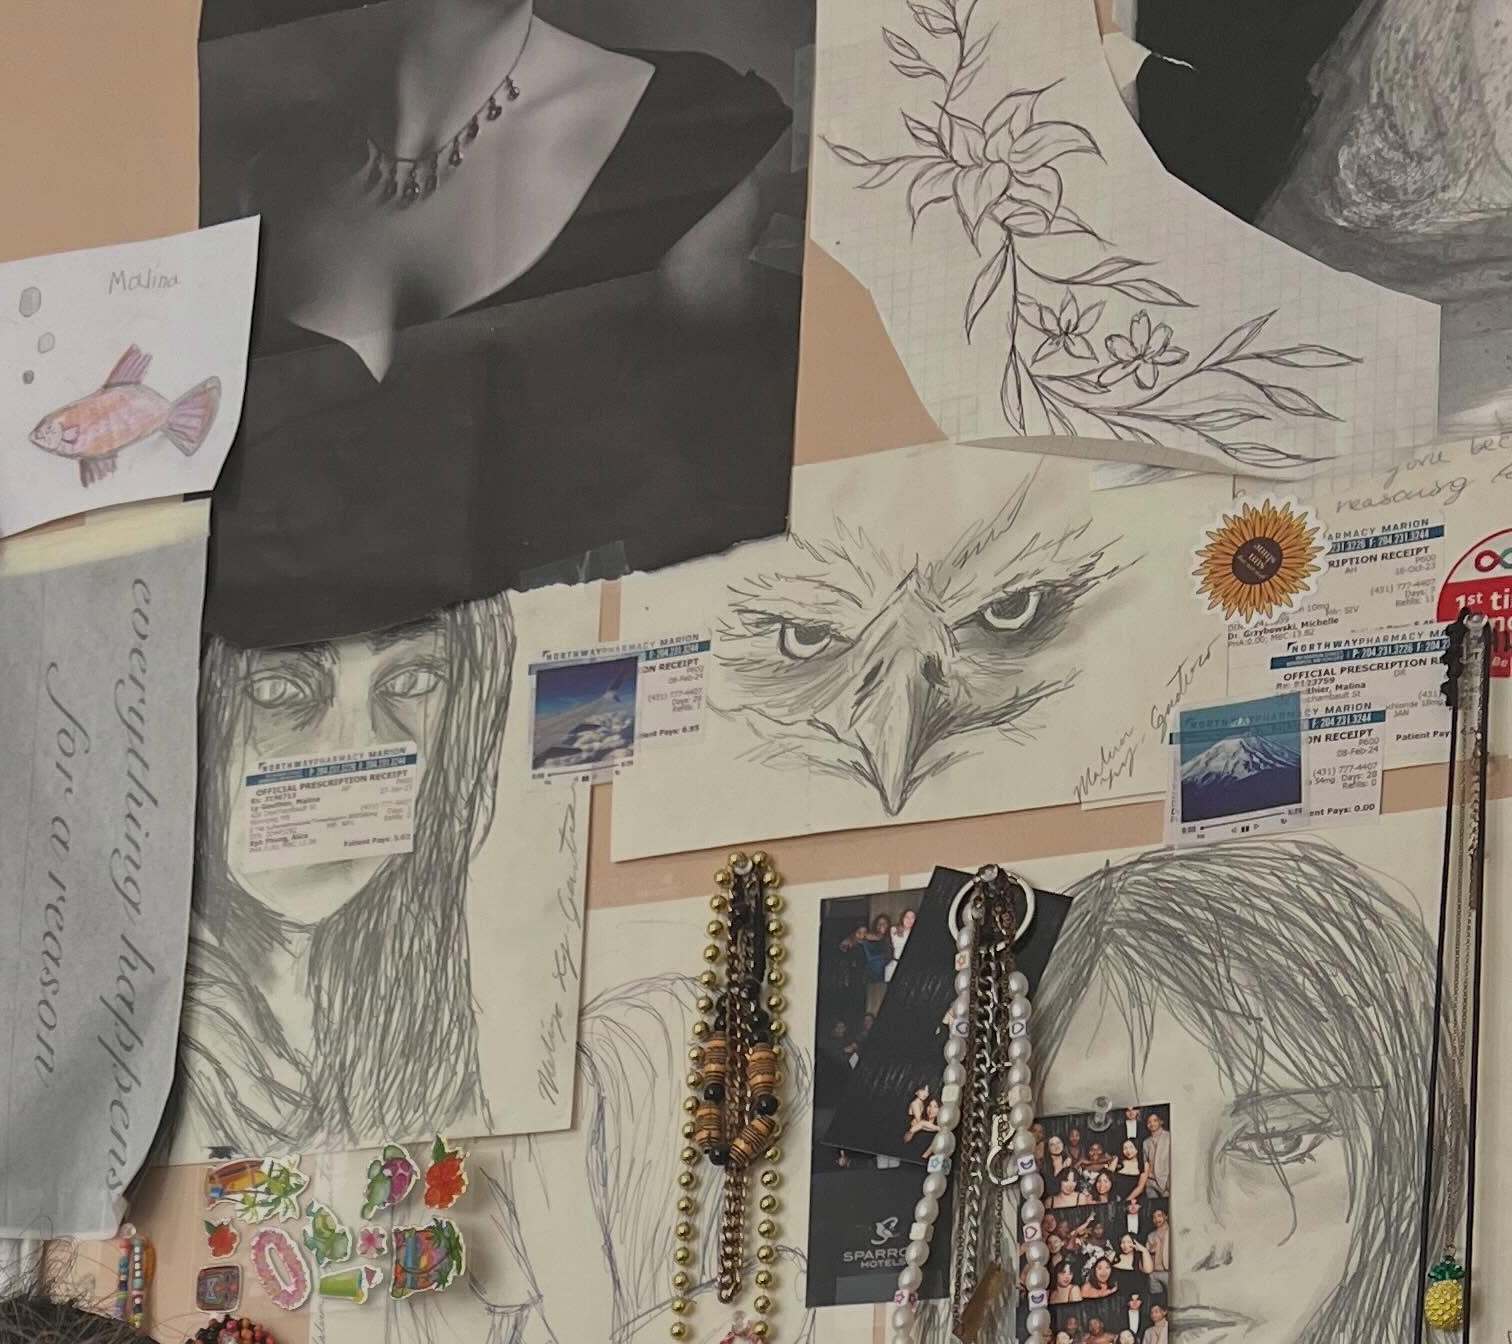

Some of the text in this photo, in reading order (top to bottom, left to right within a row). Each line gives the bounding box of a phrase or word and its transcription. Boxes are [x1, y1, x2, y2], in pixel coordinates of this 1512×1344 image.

[108, 268, 178, 295] Malina
[1382, 517, 1430, 533] MARION
[1380, 546, 1431, 562] RECEIPT
[658, 658, 699, 671] RECEIPT
[1283, 658, 1428, 682] OFFICIAL PRESCRIPTION
[1335, 682, 1366, 692] Malina
[1325, 702, 1372, 715] MARION
[1325, 728, 1374, 743] RECEIPT
[1396, 731, 1430, 742] Patient
[256, 770, 408, 796] OFFICIAL PRESCRIPTION RECEIPT
[1326, 802, 1376, 817] Pays: 0.00
[33, 661, 90, 1088] for a reason
[97, 578, 159, 1195] everything happens
[843, 1248, 907, 1262] SPARRO
